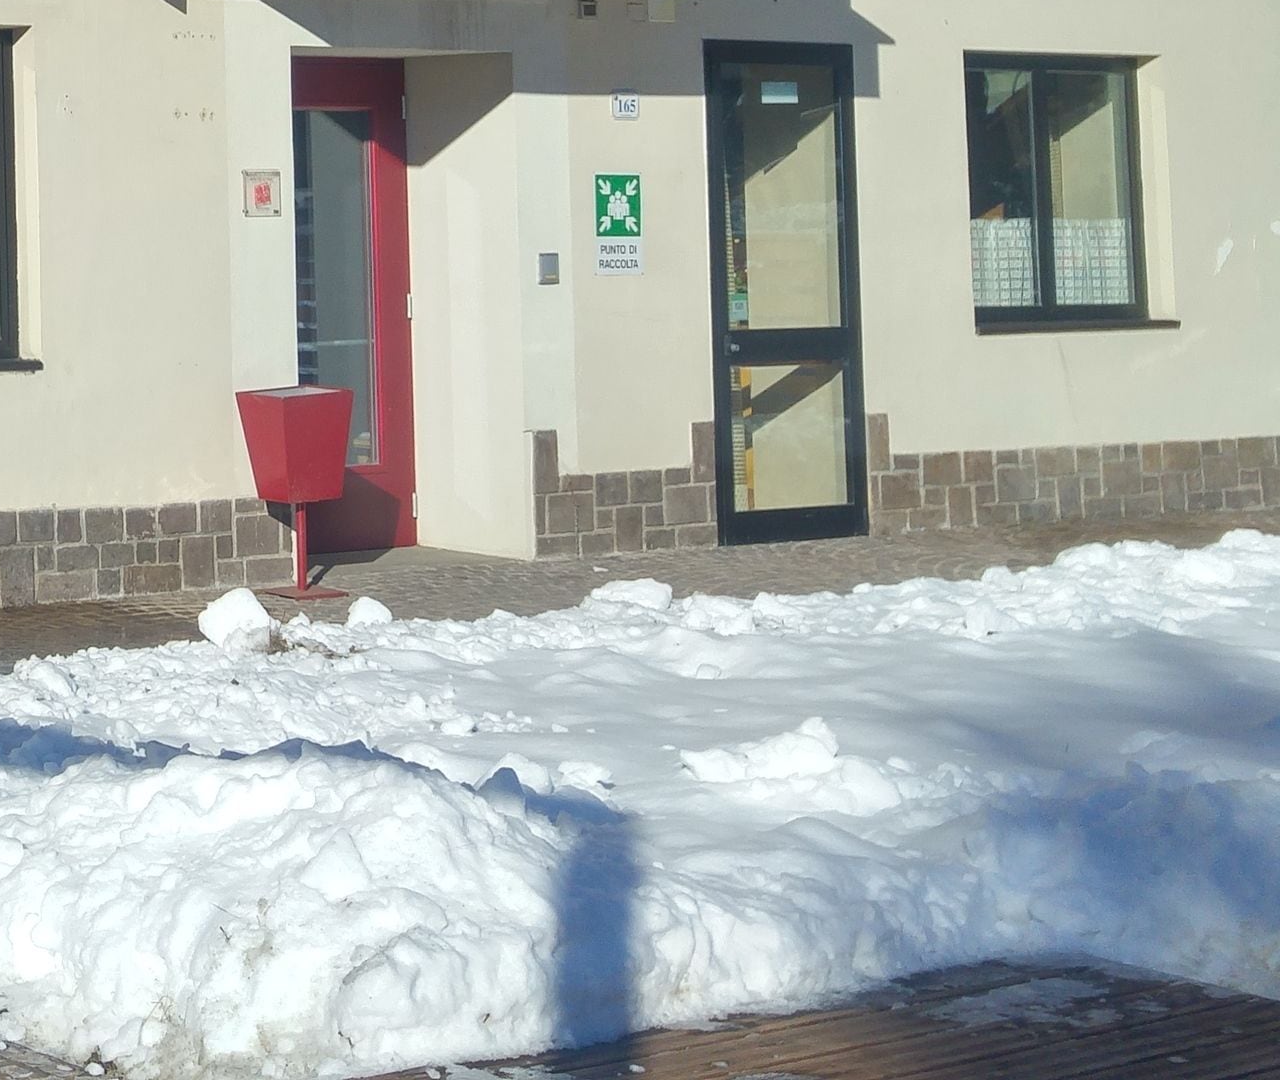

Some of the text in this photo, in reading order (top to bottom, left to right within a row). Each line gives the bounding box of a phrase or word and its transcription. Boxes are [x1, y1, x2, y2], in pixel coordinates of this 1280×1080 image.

[618, 99, 636, 113] 165
[600, 244, 638, 255] PUNTO DI
[598, 258, 639, 269] RACCOLTA
